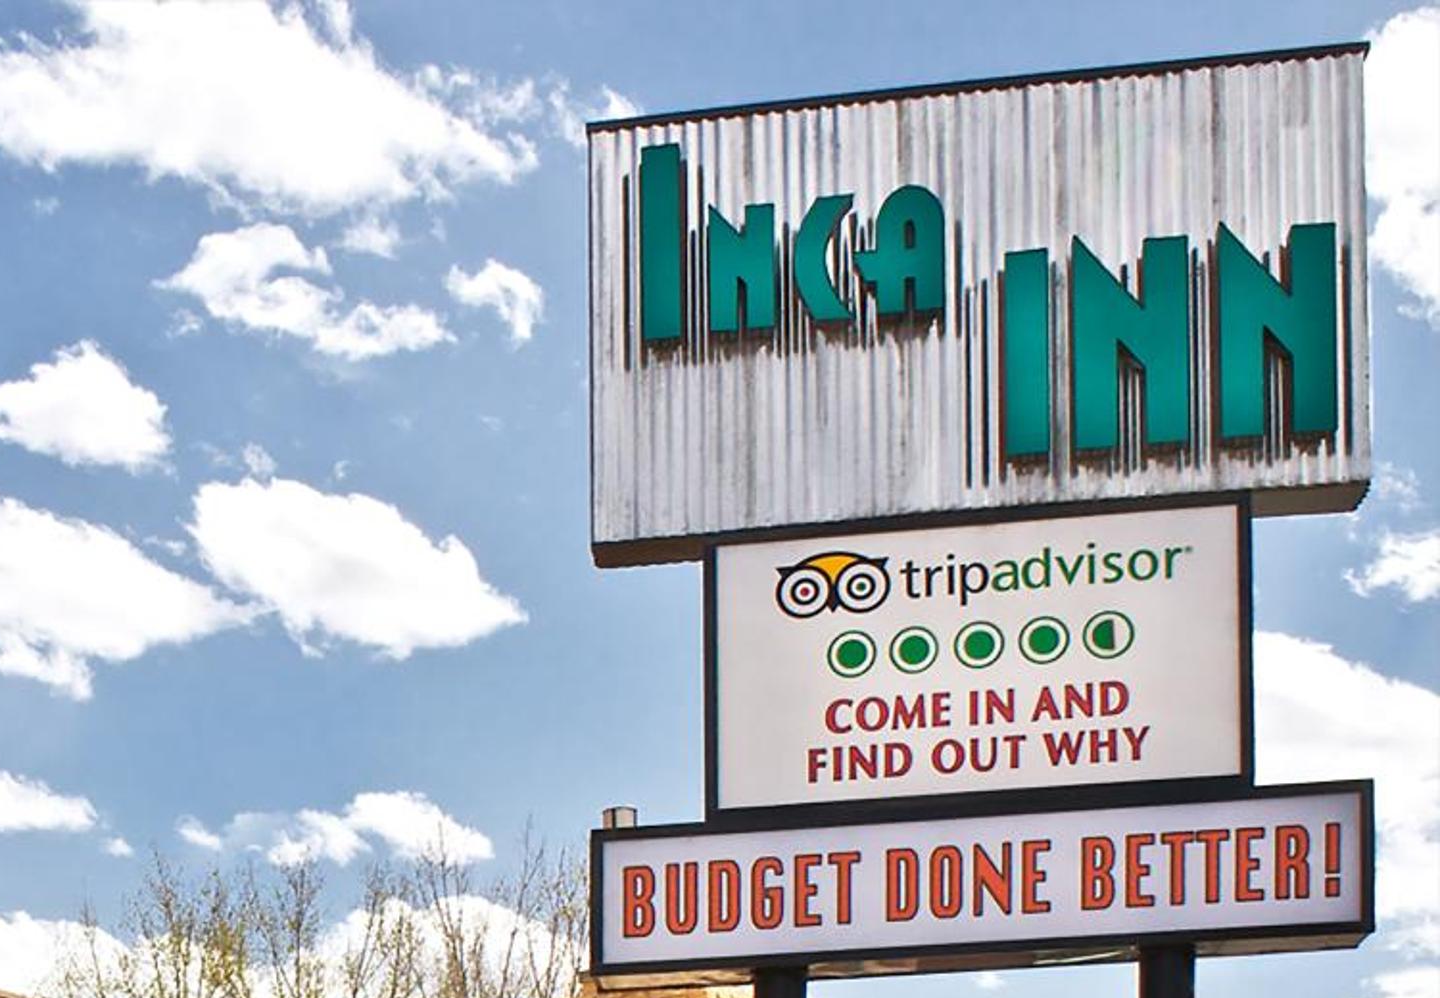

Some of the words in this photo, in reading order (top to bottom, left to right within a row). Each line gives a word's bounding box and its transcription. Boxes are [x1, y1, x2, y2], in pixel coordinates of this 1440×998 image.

[640, 142, 946, 341] INCA
[1004, 221, 1337, 457] INN
[900, 542, 1183, 605] tripadvisor
[824, 691, 952, 734] COME
[968, 688, 1016, 726] IN
[1030, 680, 1130, 722] AND
[806, 741, 913, 784] FIND
[930, 734, 1027, 773] OUT
[1042, 725, 1151, 765] WHY
[621, 850, 861, 939] BUDGET
[885, 838, 1052, 923] DONE
[1080, 821, 1342, 911] BETTER!
